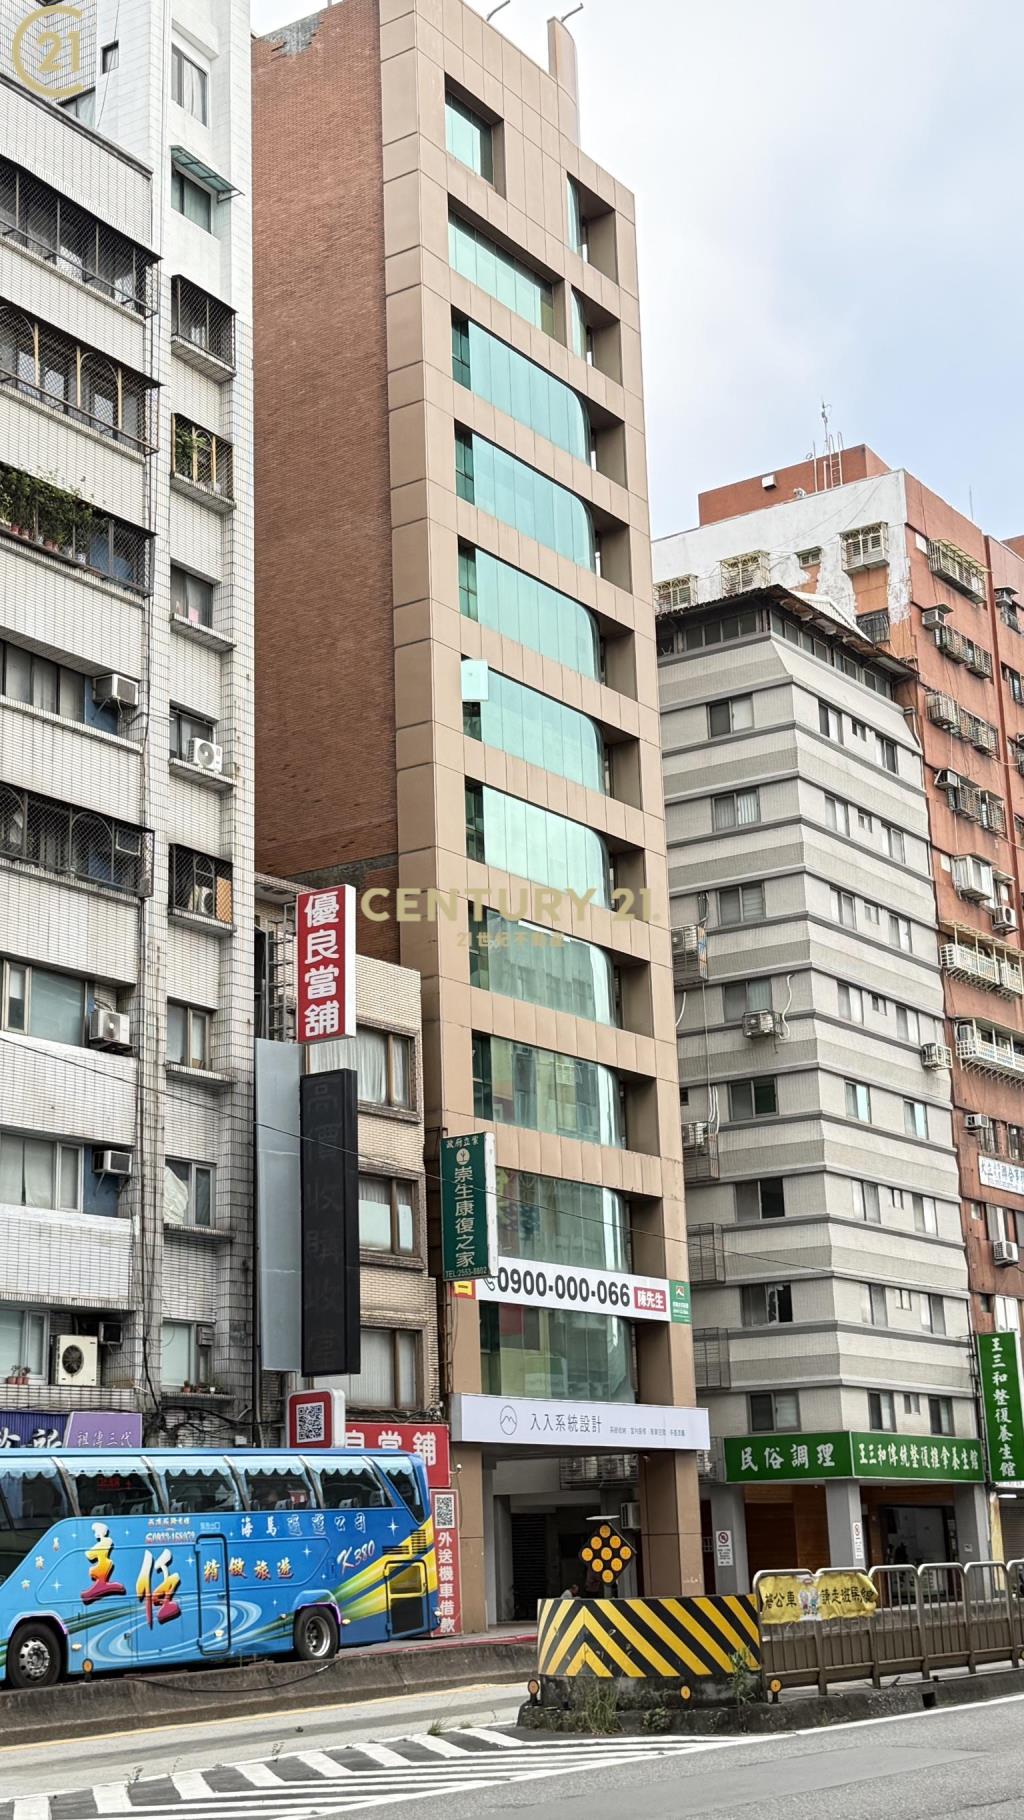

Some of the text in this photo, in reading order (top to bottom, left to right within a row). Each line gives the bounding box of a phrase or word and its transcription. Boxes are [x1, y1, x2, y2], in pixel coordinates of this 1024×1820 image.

[304, 890, 340, 1037] 優良當舖
[454, 1165, 475, 1268] 崇生康復之家
[637, 1289, 665, 1310] 陳先生
[741, 1442, 836, 1472] 民俗調理
[991, 1337, 1016, 1477] 王三和整復養生館
[438, 1531, 455, 1633] 外送機車借款
